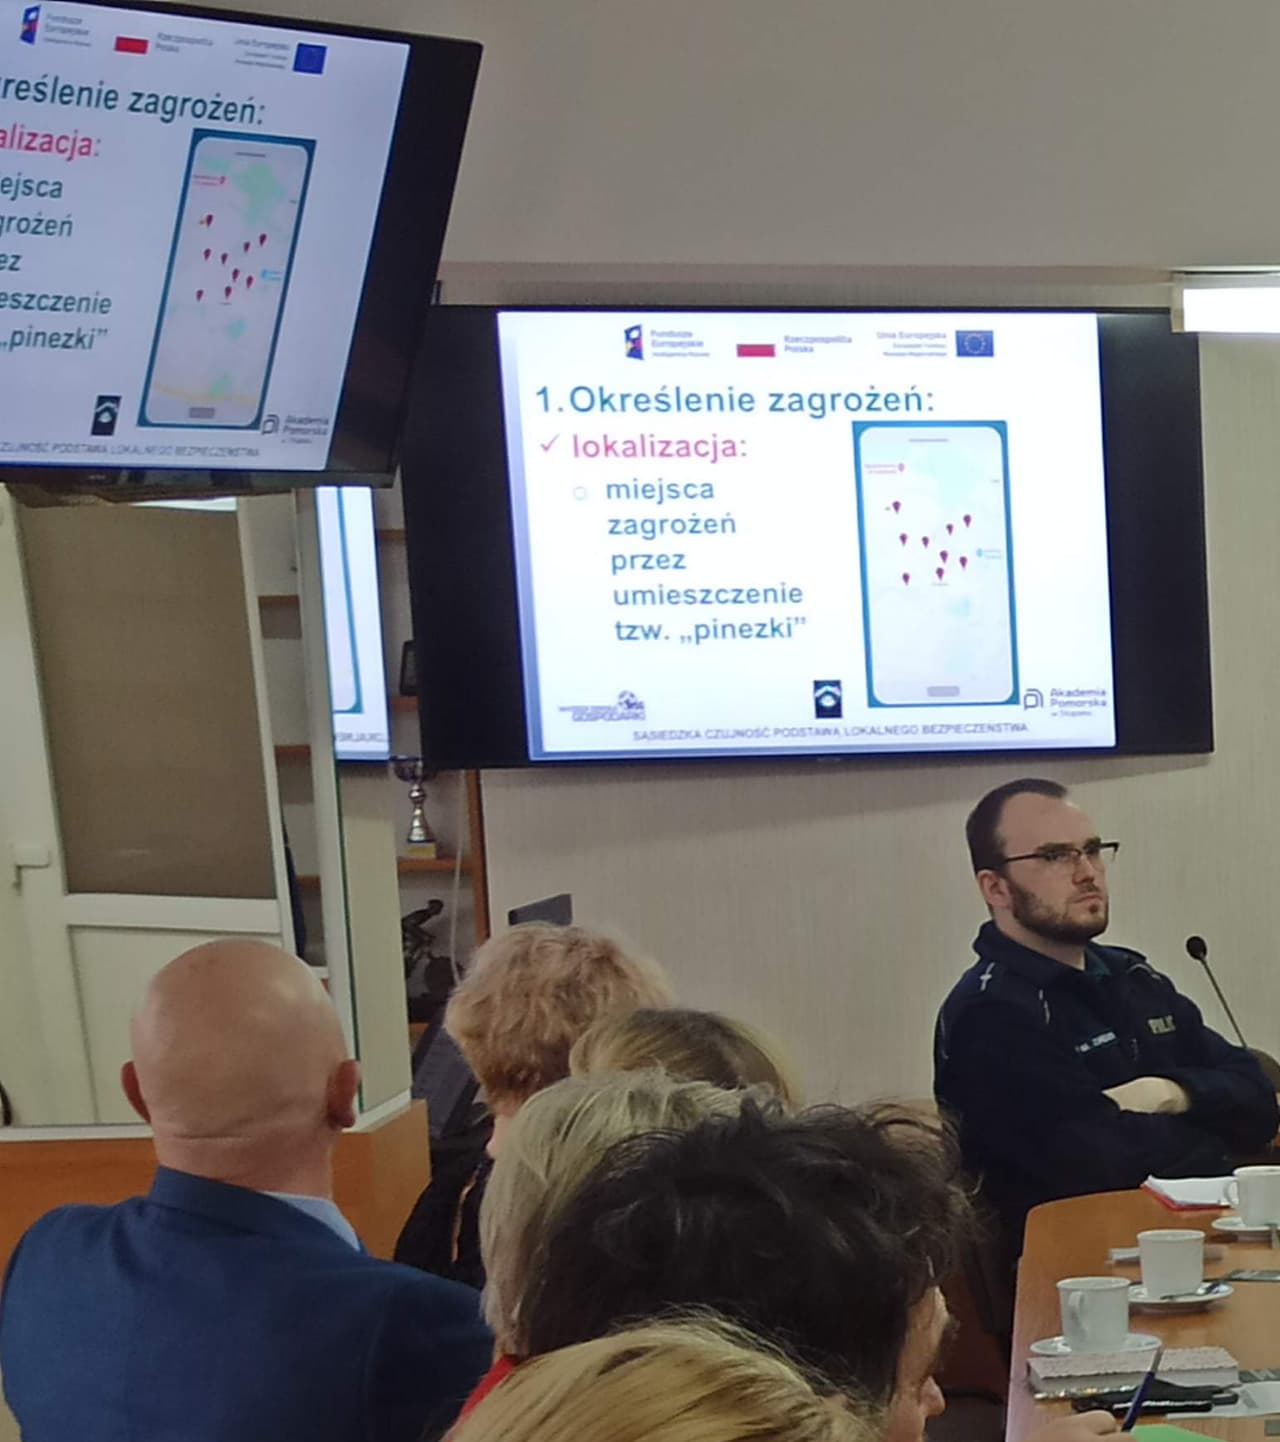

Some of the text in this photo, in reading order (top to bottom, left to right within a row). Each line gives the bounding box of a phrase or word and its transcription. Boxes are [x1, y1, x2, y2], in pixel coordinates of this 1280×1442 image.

[0, 74, 265, 125] reślenie zagrożeń:
[0, 172, 63, 202] ejsca
[768, 386, 934, 419] zagrożeń:
[572, 433, 747, 464] lokalizacja:
[606, 477, 714, 505] miejsca
[608, 511, 737, 540] zagrożeń
[611, 553, 687, 575] przez
[613, 581, 803, 605] umieszczenie
[615, 620, 670, 641] tzw.
